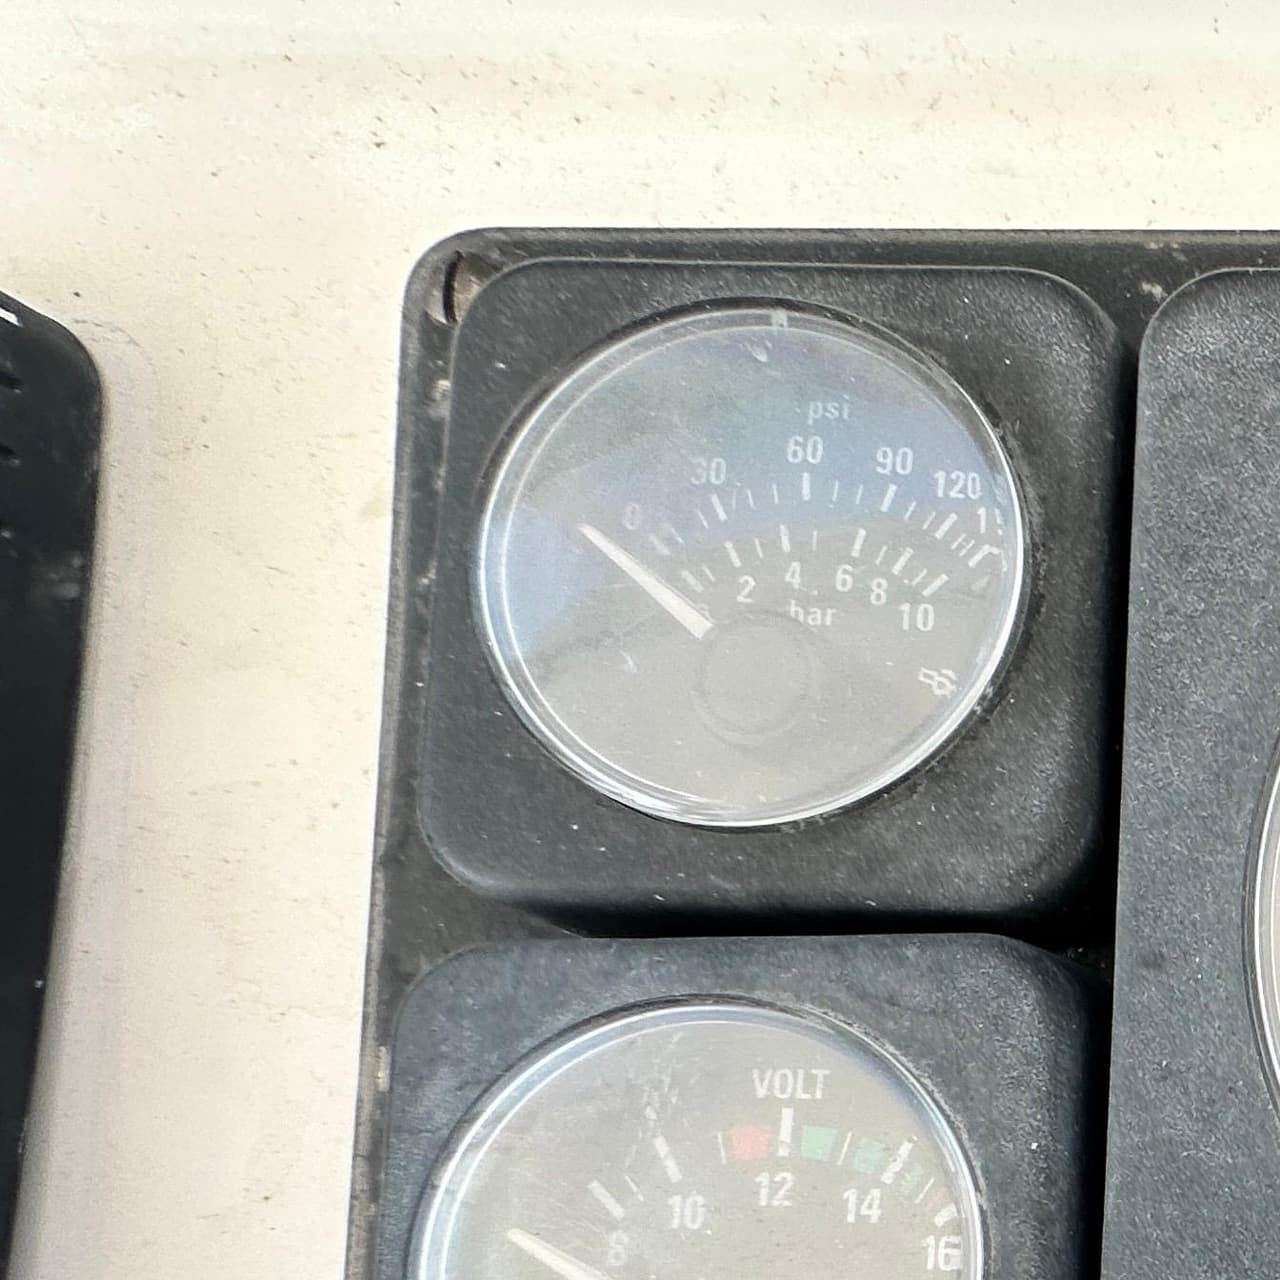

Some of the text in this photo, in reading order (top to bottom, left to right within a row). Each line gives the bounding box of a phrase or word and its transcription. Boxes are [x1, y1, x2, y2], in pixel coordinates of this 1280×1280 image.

[786, 435, 823, 464] 60
[876, 448, 912, 475] 90
[690, 457, 727, 485] 30
[933, 469, 982, 499] 120
[737, 575, 756, 603] 2
[785, 562, 802, 589] 4
[835, 564, 854, 592] 6
[870, 577, 888, 605] 8
[899, 603, 934, 631] 10
[752, 1068, 830, 1099] VOLT
[754, 1172, 794, 1207] 12
[667, 1194, 705, 1230] 10
[842, 1189, 882, 1224] 14
[926, 1234, 962, 1271] 16
